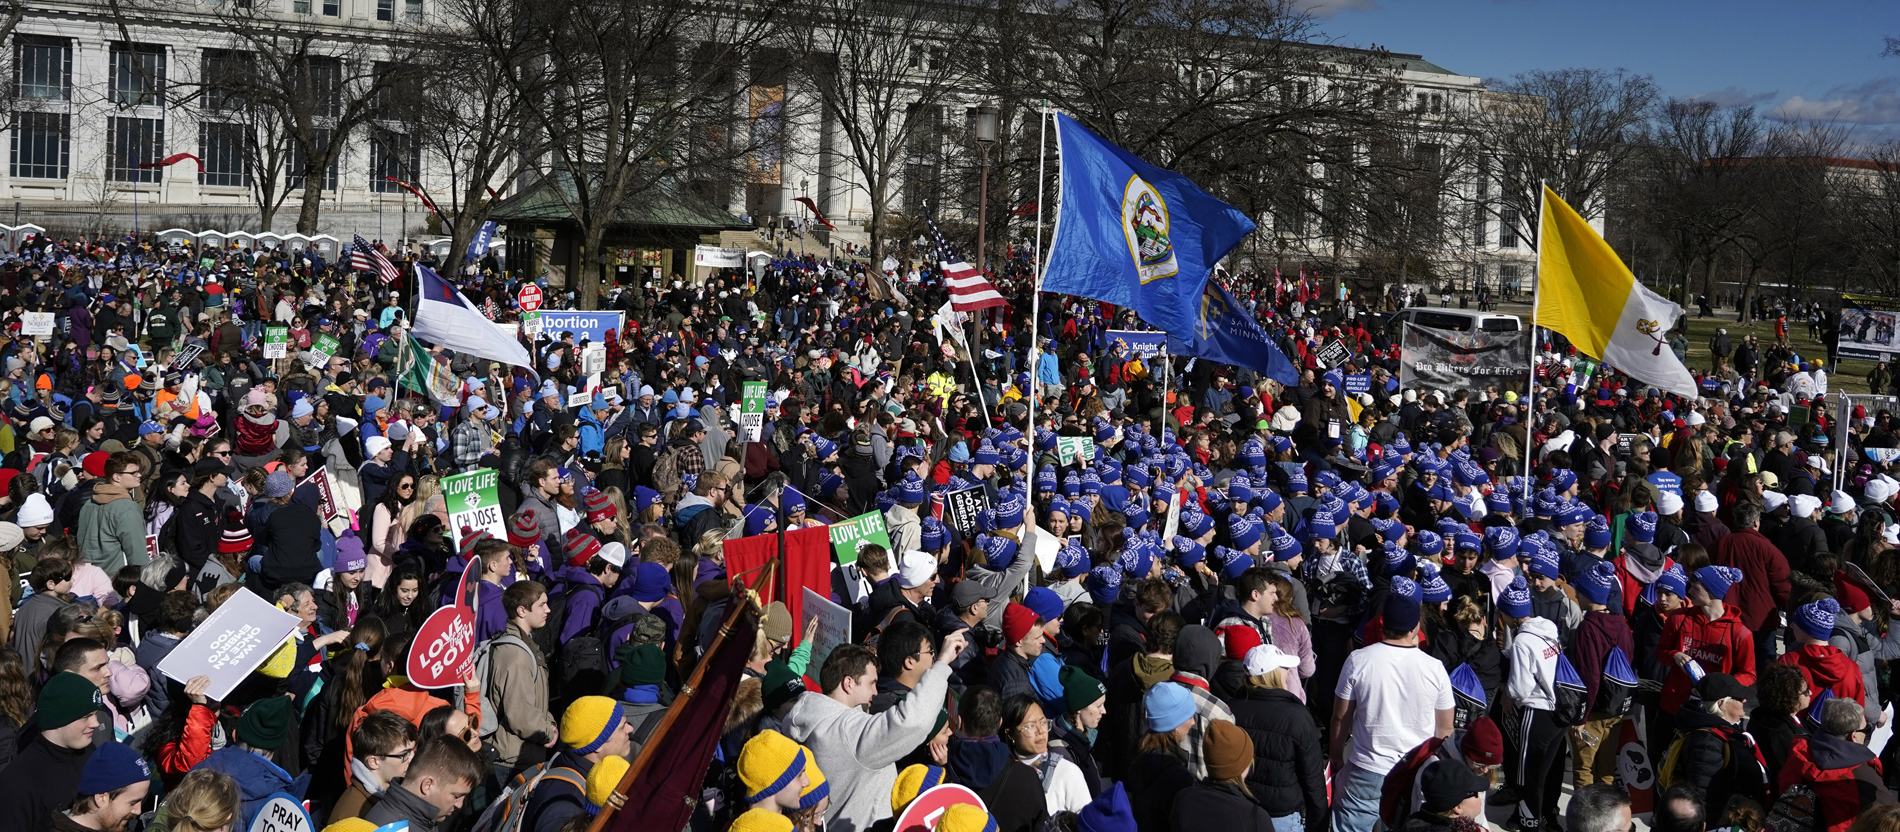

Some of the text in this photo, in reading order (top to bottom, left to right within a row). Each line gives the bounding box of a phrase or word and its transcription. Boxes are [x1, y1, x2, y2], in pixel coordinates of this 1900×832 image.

[475, 220, 492, 255] PEN
[525, 286, 536, 294] STOP
[1231, 318, 1260, 332] SAINT
[1133, 342, 1157, 352] Knight
[1415, 362, 1514, 375] Pro Bikers For Life
[744, 385, 766, 398] LOVE LIFE
[743, 414, 760, 426] CHOOSE
[449, 473, 496, 495] LOVE LIFE
[956, 494, 971, 538] GENERATIO
[833, 514, 883, 545] LOVE LIFE
[208, 624, 252, 663] EMBRYO
[210, 629, 235, 649] TOO
[213, 627, 260, 670] ONCE AN
[419, 614, 463, 669] LOVE
[230, 644, 257, 666] WAS
[431, 621, 474, 680] BOTH
[1690, 648, 1723, 664] FAMILY
[272, 803, 302, 831] PRAY
